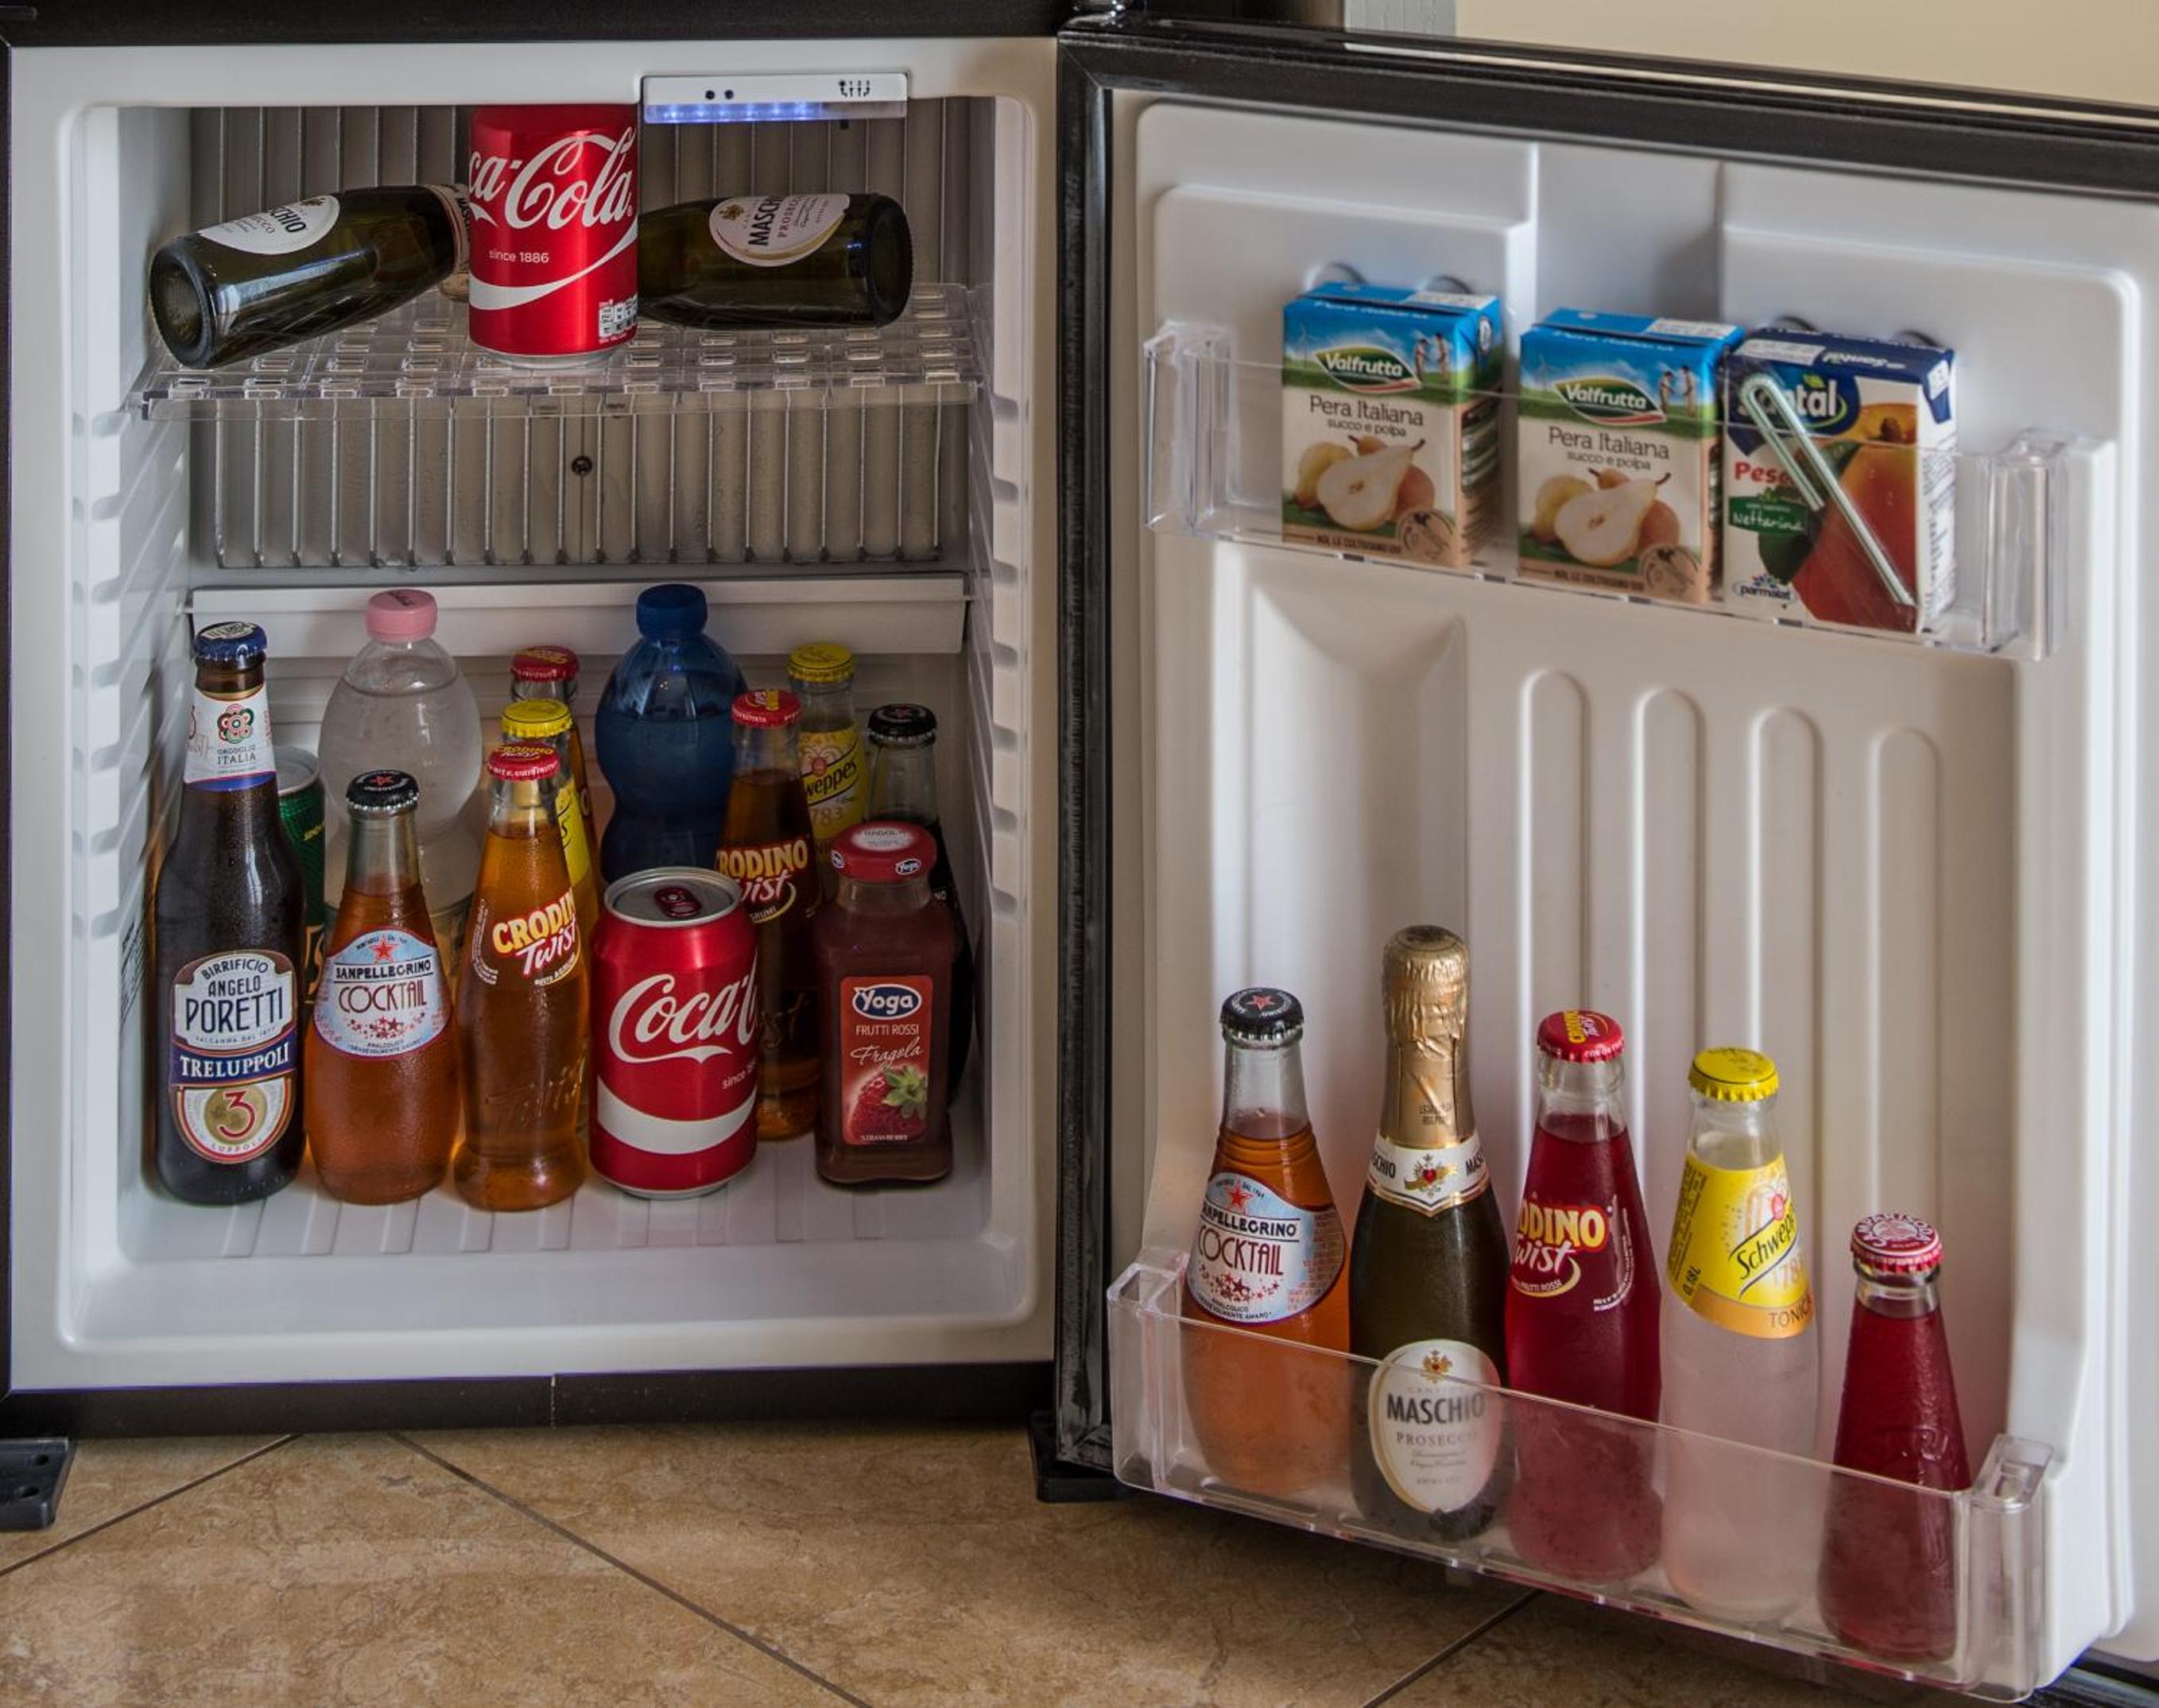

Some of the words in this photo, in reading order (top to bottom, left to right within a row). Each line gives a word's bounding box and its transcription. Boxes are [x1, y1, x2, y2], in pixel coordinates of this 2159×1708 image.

[469, 126, 635, 230] ca-Cola
[489, 249, 517, 263] since
[519, 251, 549, 264] 1886
[1325, 352, 1403, 377] Valfrutta
[1310, 394, 1352, 418] Pera
[1358, 399, 1424, 427] Italiana
[1565, 384, 1647, 410] Valfrutta
[1328, 418, 1362, 432] succo
[1364, 424, 1373, 433] e
[1374, 424, 1406, 439] polpa
[1549, 426, 1592, 450] Pera
[1598, 432, 1669, 459] Italiana
[1567, 451, 1604, 464] succo
[1606, 456, 1614, 466] e
[1616, 456, 1652, 471] polpa
[217, 752, 256, 765] ITALIA
[716, 839, 808, 879] RODINO
[493, 886, 576, 955] CRODIN
[516, 913, 577, 976] Twist
[201, 959, 269, 981] BIRRIFICIO
[208, 975, 261, 997] ANGELO
[335, 959, 432, 981] SANPELLEGRINO
[185, 986, 283, 1034] PORETTI
[339, 981, 427, 1013] COCKTAIL
[859, 990, 914, 1015] Yoga
[855, 1024, 890, 1036] FRUTTI
[891, 1024, 919, 1036] ROSSI
[179, 1042, 290, 1079] TRELUPPOLI
[851, 1036, 922, 1068] Fragola
[218, 1090, 255, 1139] 3
[1198, 1225, 1284, 1276] COCKTAIL
[1387, 1392, 1486, 1424] MASCHIO
